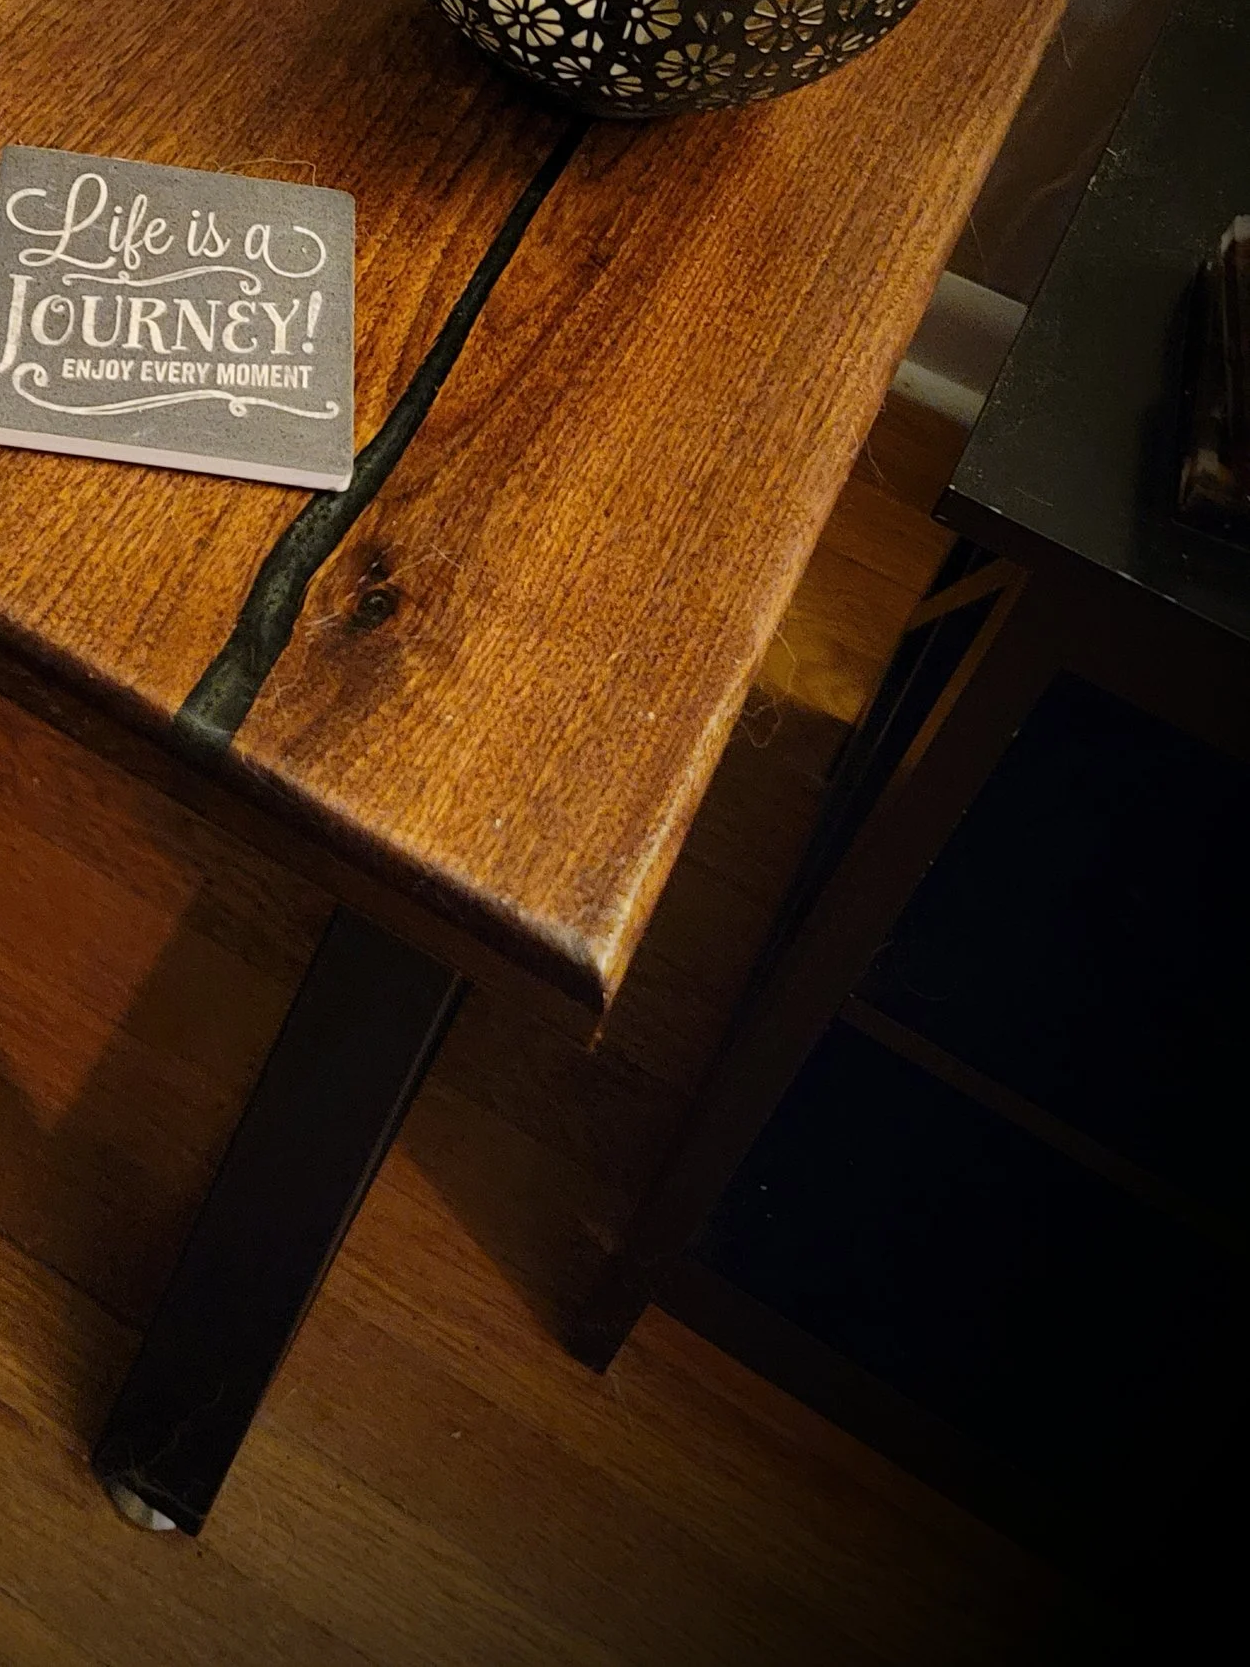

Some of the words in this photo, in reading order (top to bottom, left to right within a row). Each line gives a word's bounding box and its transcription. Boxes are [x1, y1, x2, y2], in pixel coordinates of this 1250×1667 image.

[6, 173, 174, 270] Life
[187, 210, 230, 257] is
[62, 359, 134, 381] ENJOY
[141, 361, 210, 385] EVERY
[216, 364, 312, 389] MOMENT
